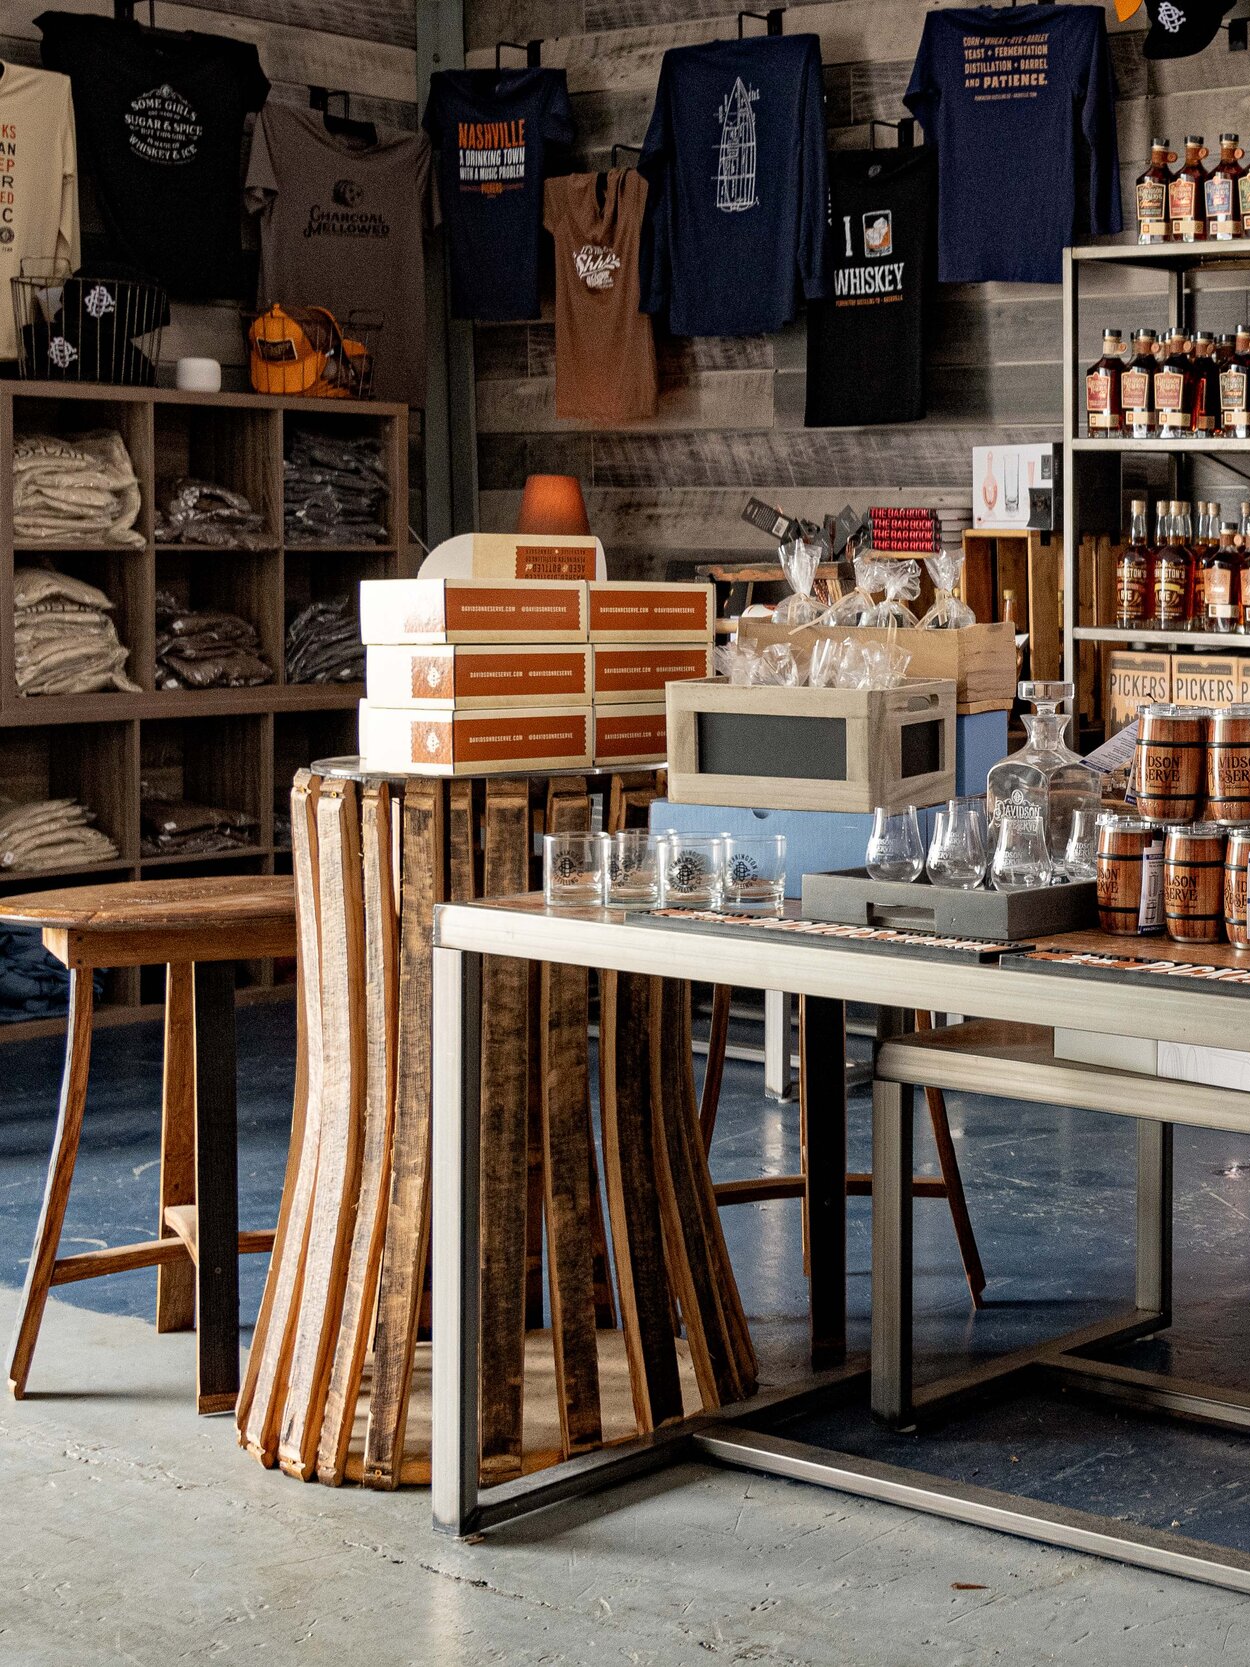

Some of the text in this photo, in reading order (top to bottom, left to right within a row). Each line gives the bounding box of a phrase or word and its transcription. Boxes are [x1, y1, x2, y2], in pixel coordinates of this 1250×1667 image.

[965, 44, 1048, 60] YEAST FERMENTATION
[965, 58, 1048, 75] DISTILLATION BARREL
[965, 78, 980, 88] AND
[131, 98, 197, 121] SOME GIRLS
[125, 113, 161, 129] SUGAR
[173, 122, 203, 137] SPICE
[458, 119, 525, 150] NASHVILLE
[129, 133, 171, 160] WHISKEY
[181, 144, 198, 158] ICE
[465, 148, 501, 167] DRINKING
[504, 146, 525, 165] TOWN
[843, 215, 854, 257] I
[834, 262, 905, 296] WHISKEY
[871, 506, 929, 519] THE BAR BOOK
[873, 530, 933, 540] THE BAR BOOK
[874, 519, 933, 530] THE BAR BOOK
[873, 540, 933, 551] THE BAR BOOK
[1110, 674, 1166, 699] PICKERS
[1176, 678, 1234, 703] PICKERS
[995, 800, 1042, 821] DAVIDSON
